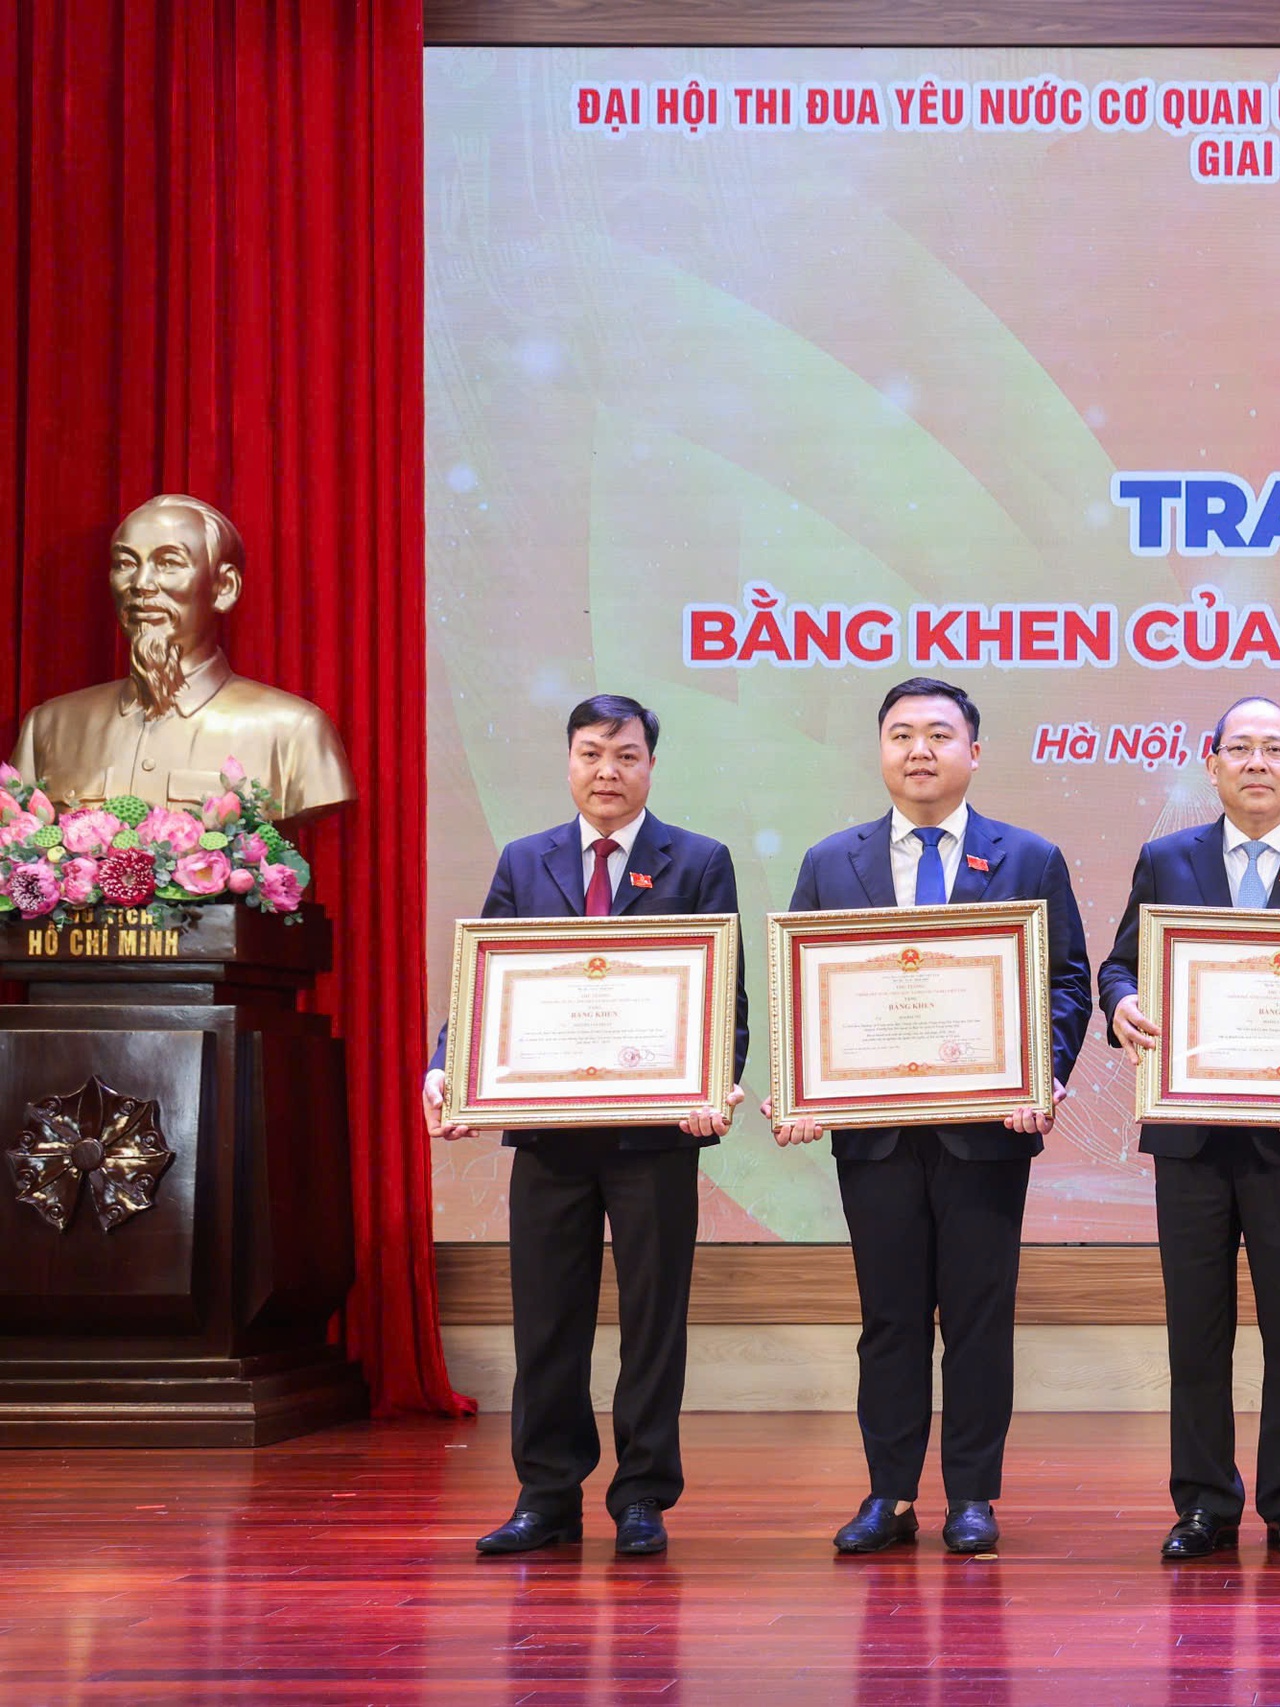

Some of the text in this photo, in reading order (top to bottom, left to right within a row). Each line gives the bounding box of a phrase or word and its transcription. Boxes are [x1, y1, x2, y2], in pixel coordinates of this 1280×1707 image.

[577, 88, 640, 132] ĐẠI
[656, 80, 717, 132] HỘI
[734, 89, 791, 124] THI
[805, 89, 880, 124] ĐUA
[895, 80, 964, 124] YÊU
[980, 80, 1082, 124] NƯỚC
[1098, 85, 1148, 124] CƠ
[1163, 89, 1262, 129] QUAN
[1198, 141, 1273, 176] GIAI
[691, 588, 894, 661] BẰNG
[916, 610, 1110, 661] KHEN
[1037, 727, 1096, 760] Hà
[1109, 725, 1187, 767] Nội,
[70, 922, 109, 956] CHÍ
[118, 929, 179, 957] MINH
